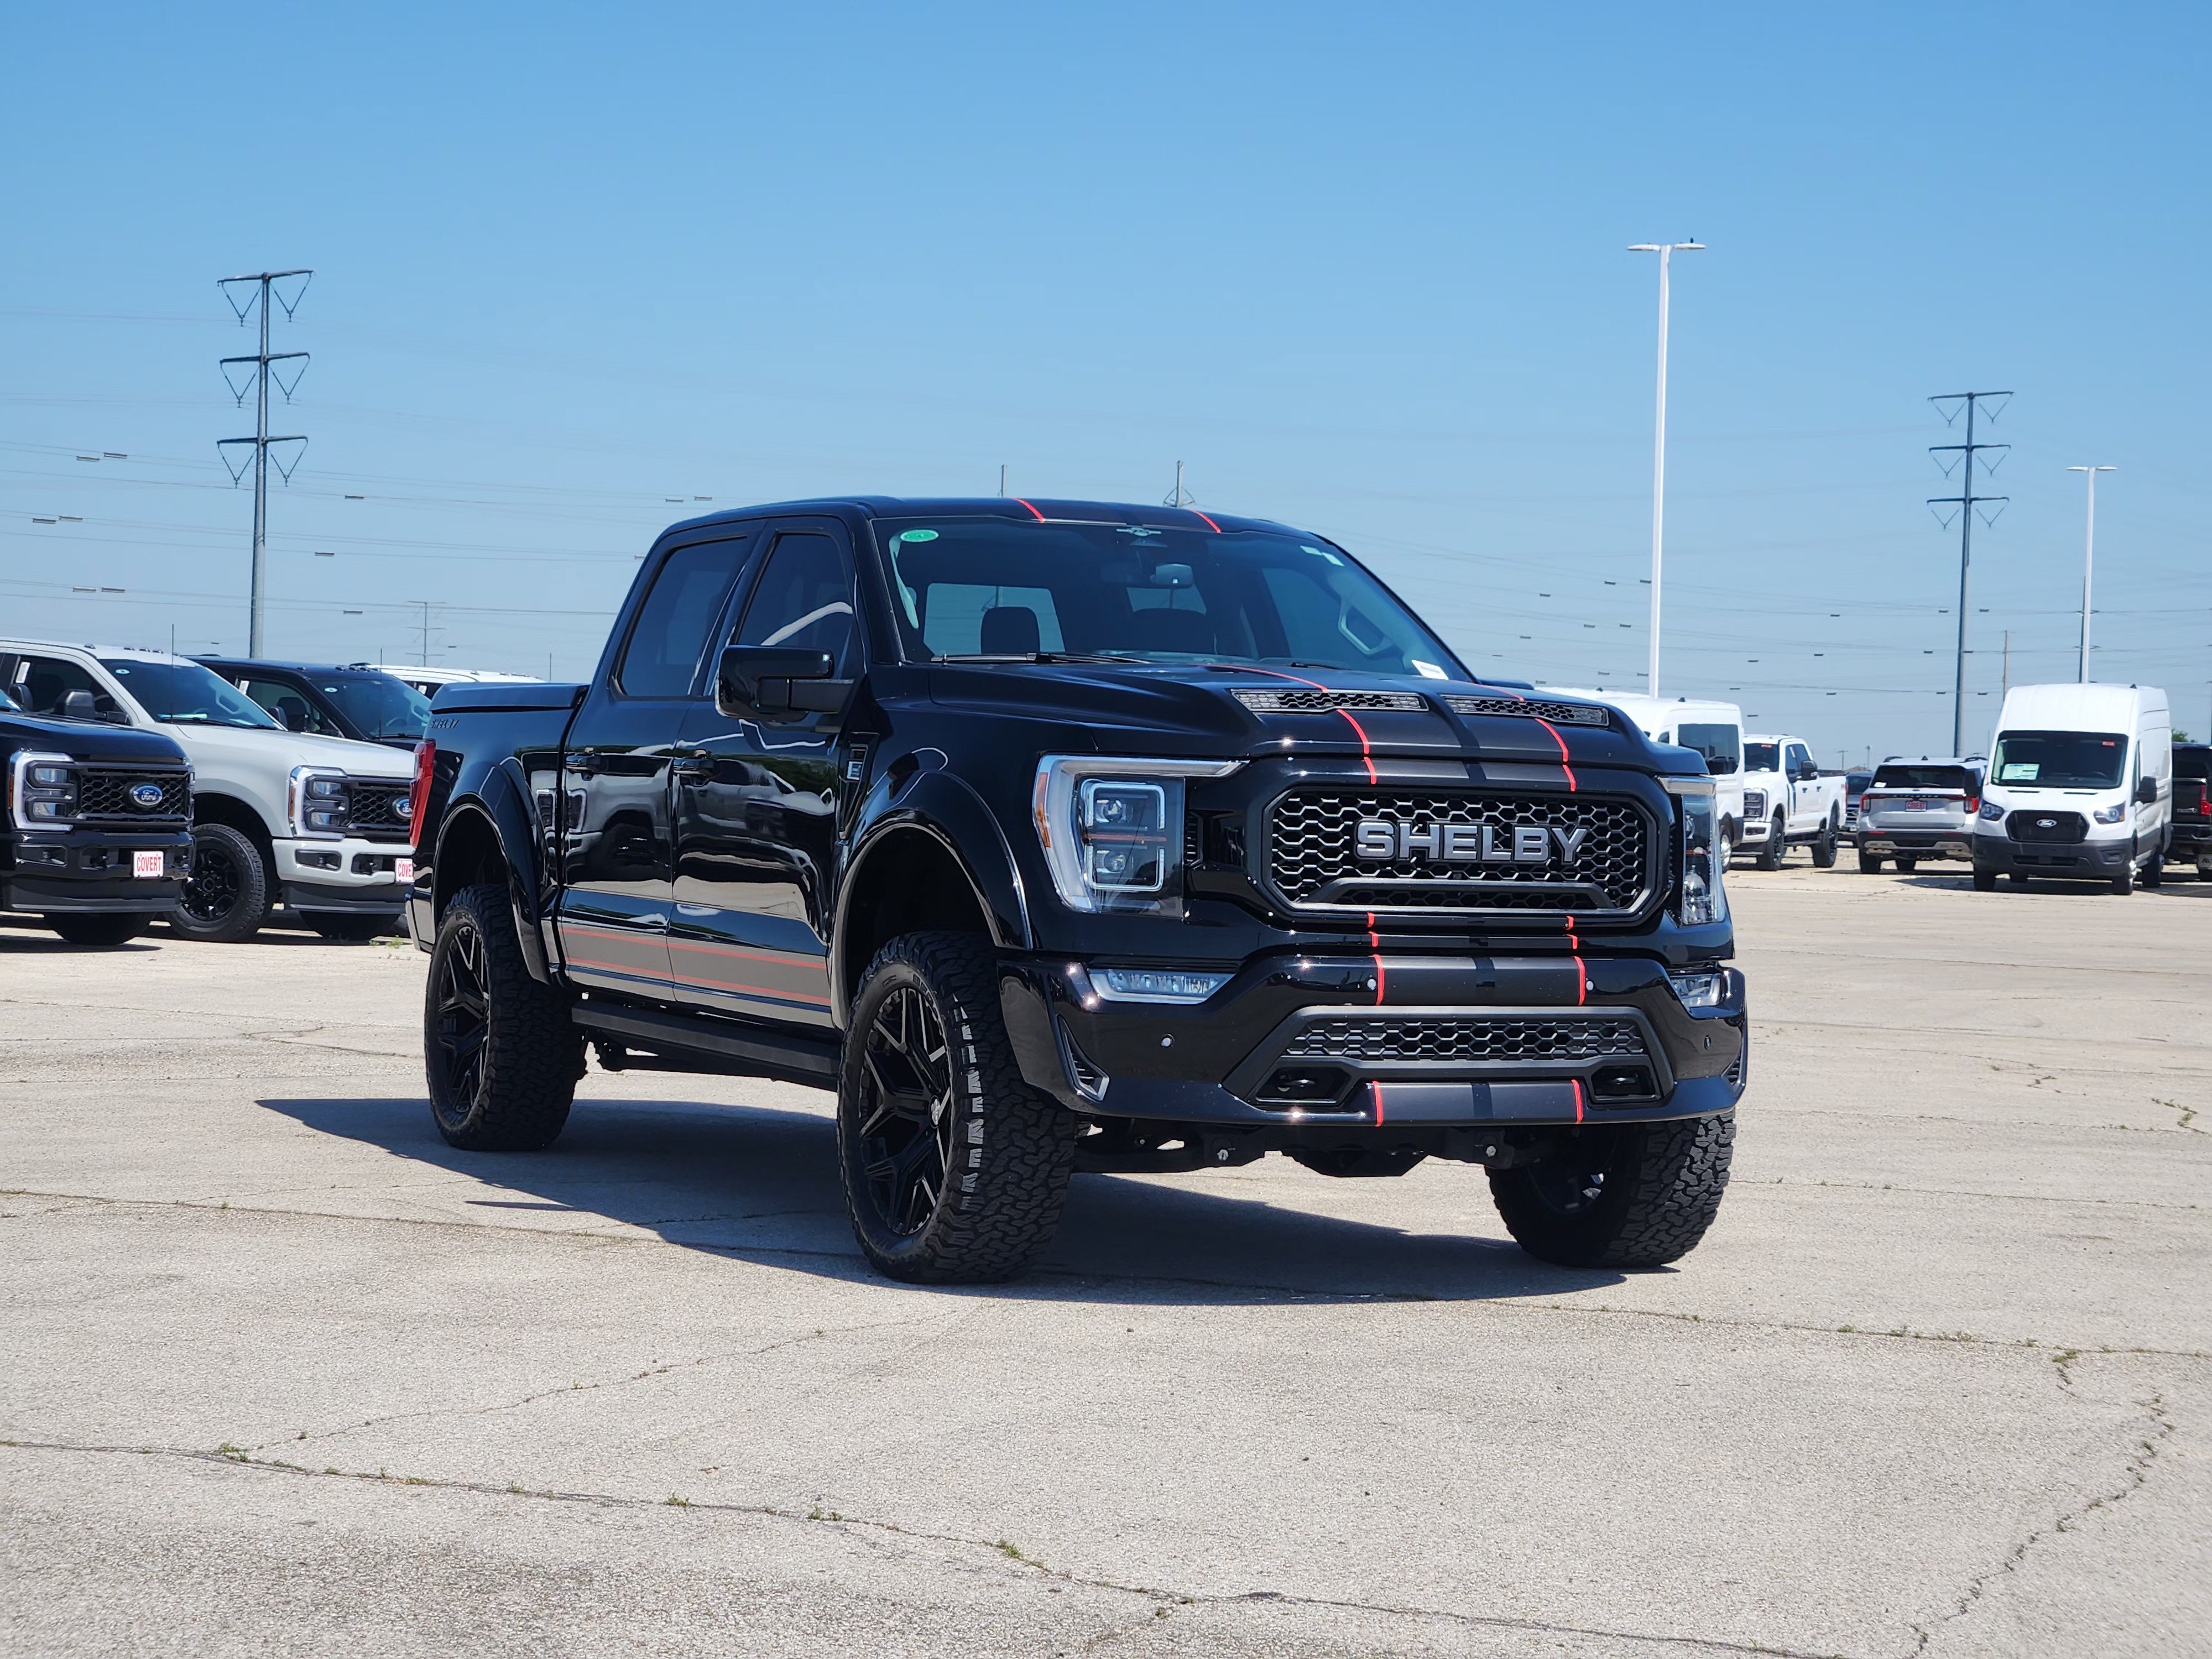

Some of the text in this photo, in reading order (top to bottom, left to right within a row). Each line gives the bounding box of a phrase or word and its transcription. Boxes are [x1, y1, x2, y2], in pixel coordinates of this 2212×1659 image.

[1357, 822, 1587, 862] SHELBY
[137, 857, 161, 872] COVERT
[398, 863, 414, 877] COVE
